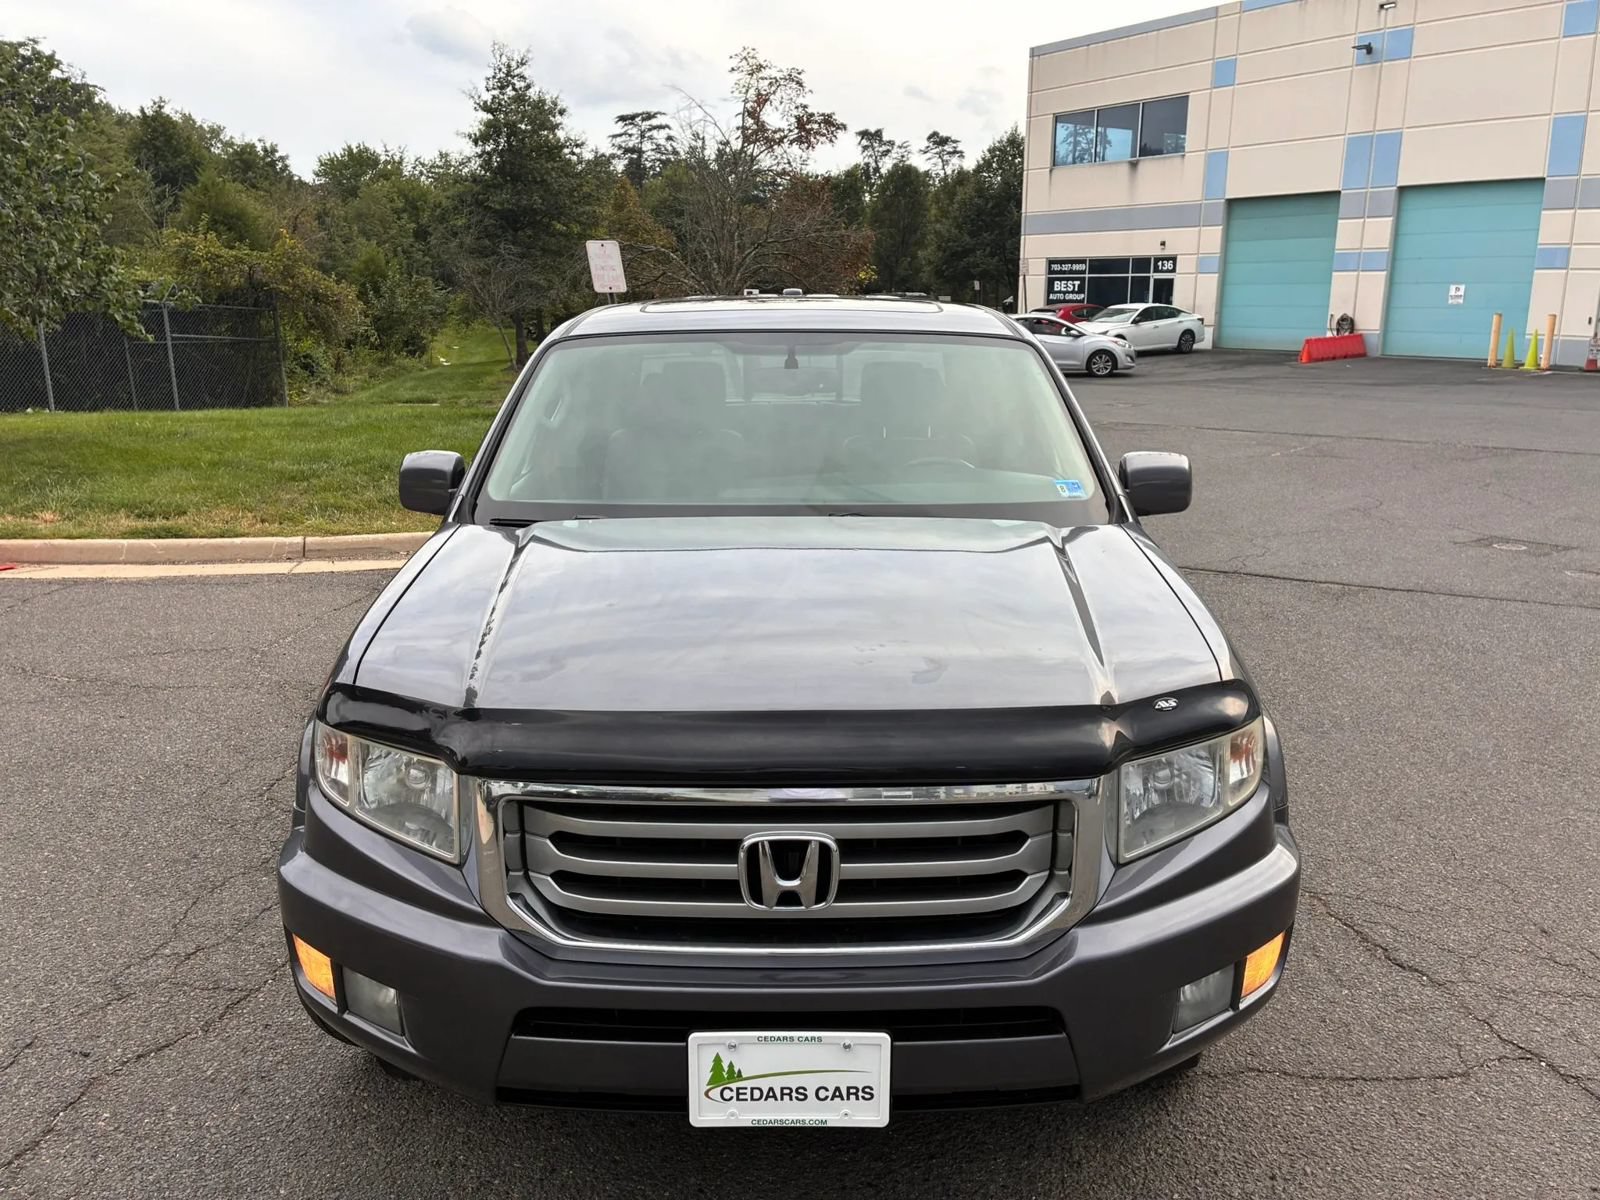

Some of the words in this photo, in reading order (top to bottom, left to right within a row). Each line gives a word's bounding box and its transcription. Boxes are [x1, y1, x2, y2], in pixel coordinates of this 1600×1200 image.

[1157, 260, 1174, 270] 136
[1054, 280, 1081, 292] BEST
[757, 1035, 795, 1043] CEDARS
[797, 1035, 823, 1043] CARS
[719, 1086, 809, 1102] CEDARS
[814, 1085, 875, 1102] CARS
[751, 1118, 828, 1126] CEDARSCARS.COM
